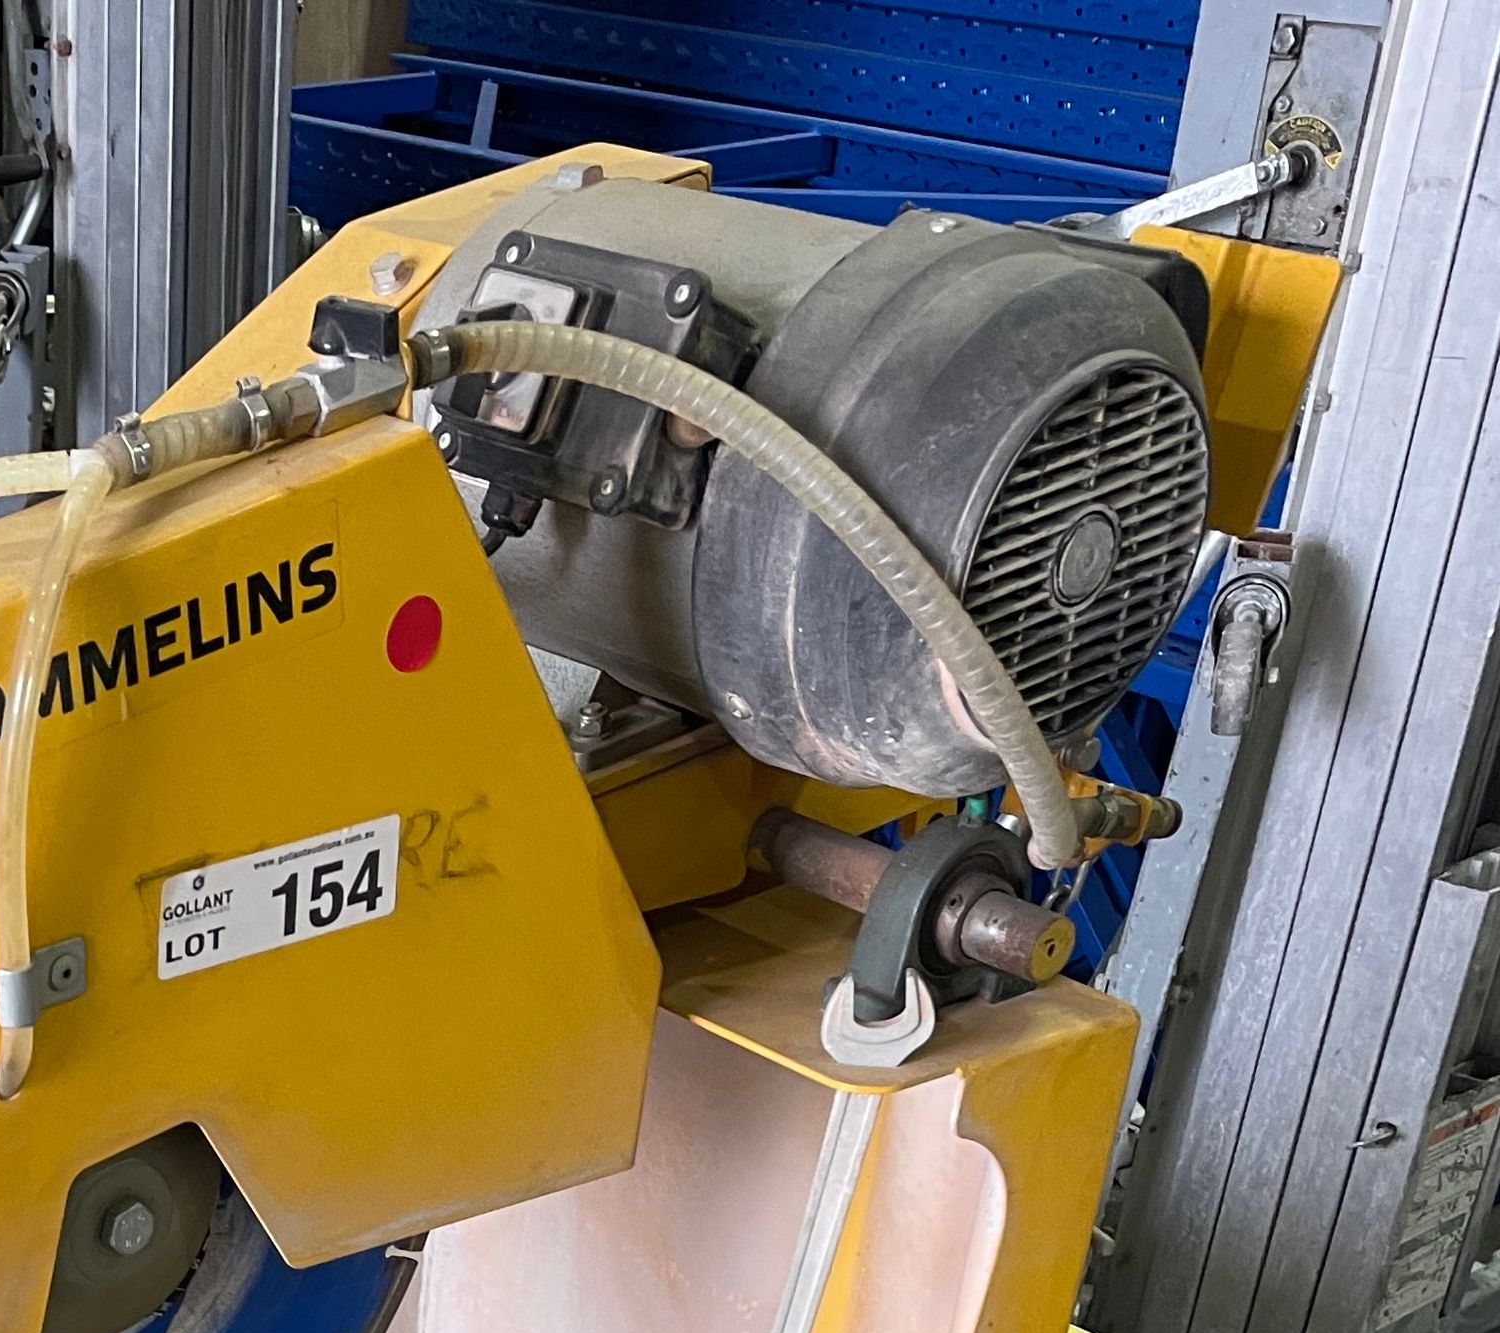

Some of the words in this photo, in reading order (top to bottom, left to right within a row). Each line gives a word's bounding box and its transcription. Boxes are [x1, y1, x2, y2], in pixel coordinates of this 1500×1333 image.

[163, 889, 234, 921] GOLLANT
[165, 926, 227, 964] LOT
[272, 849, 384, 936] 154
